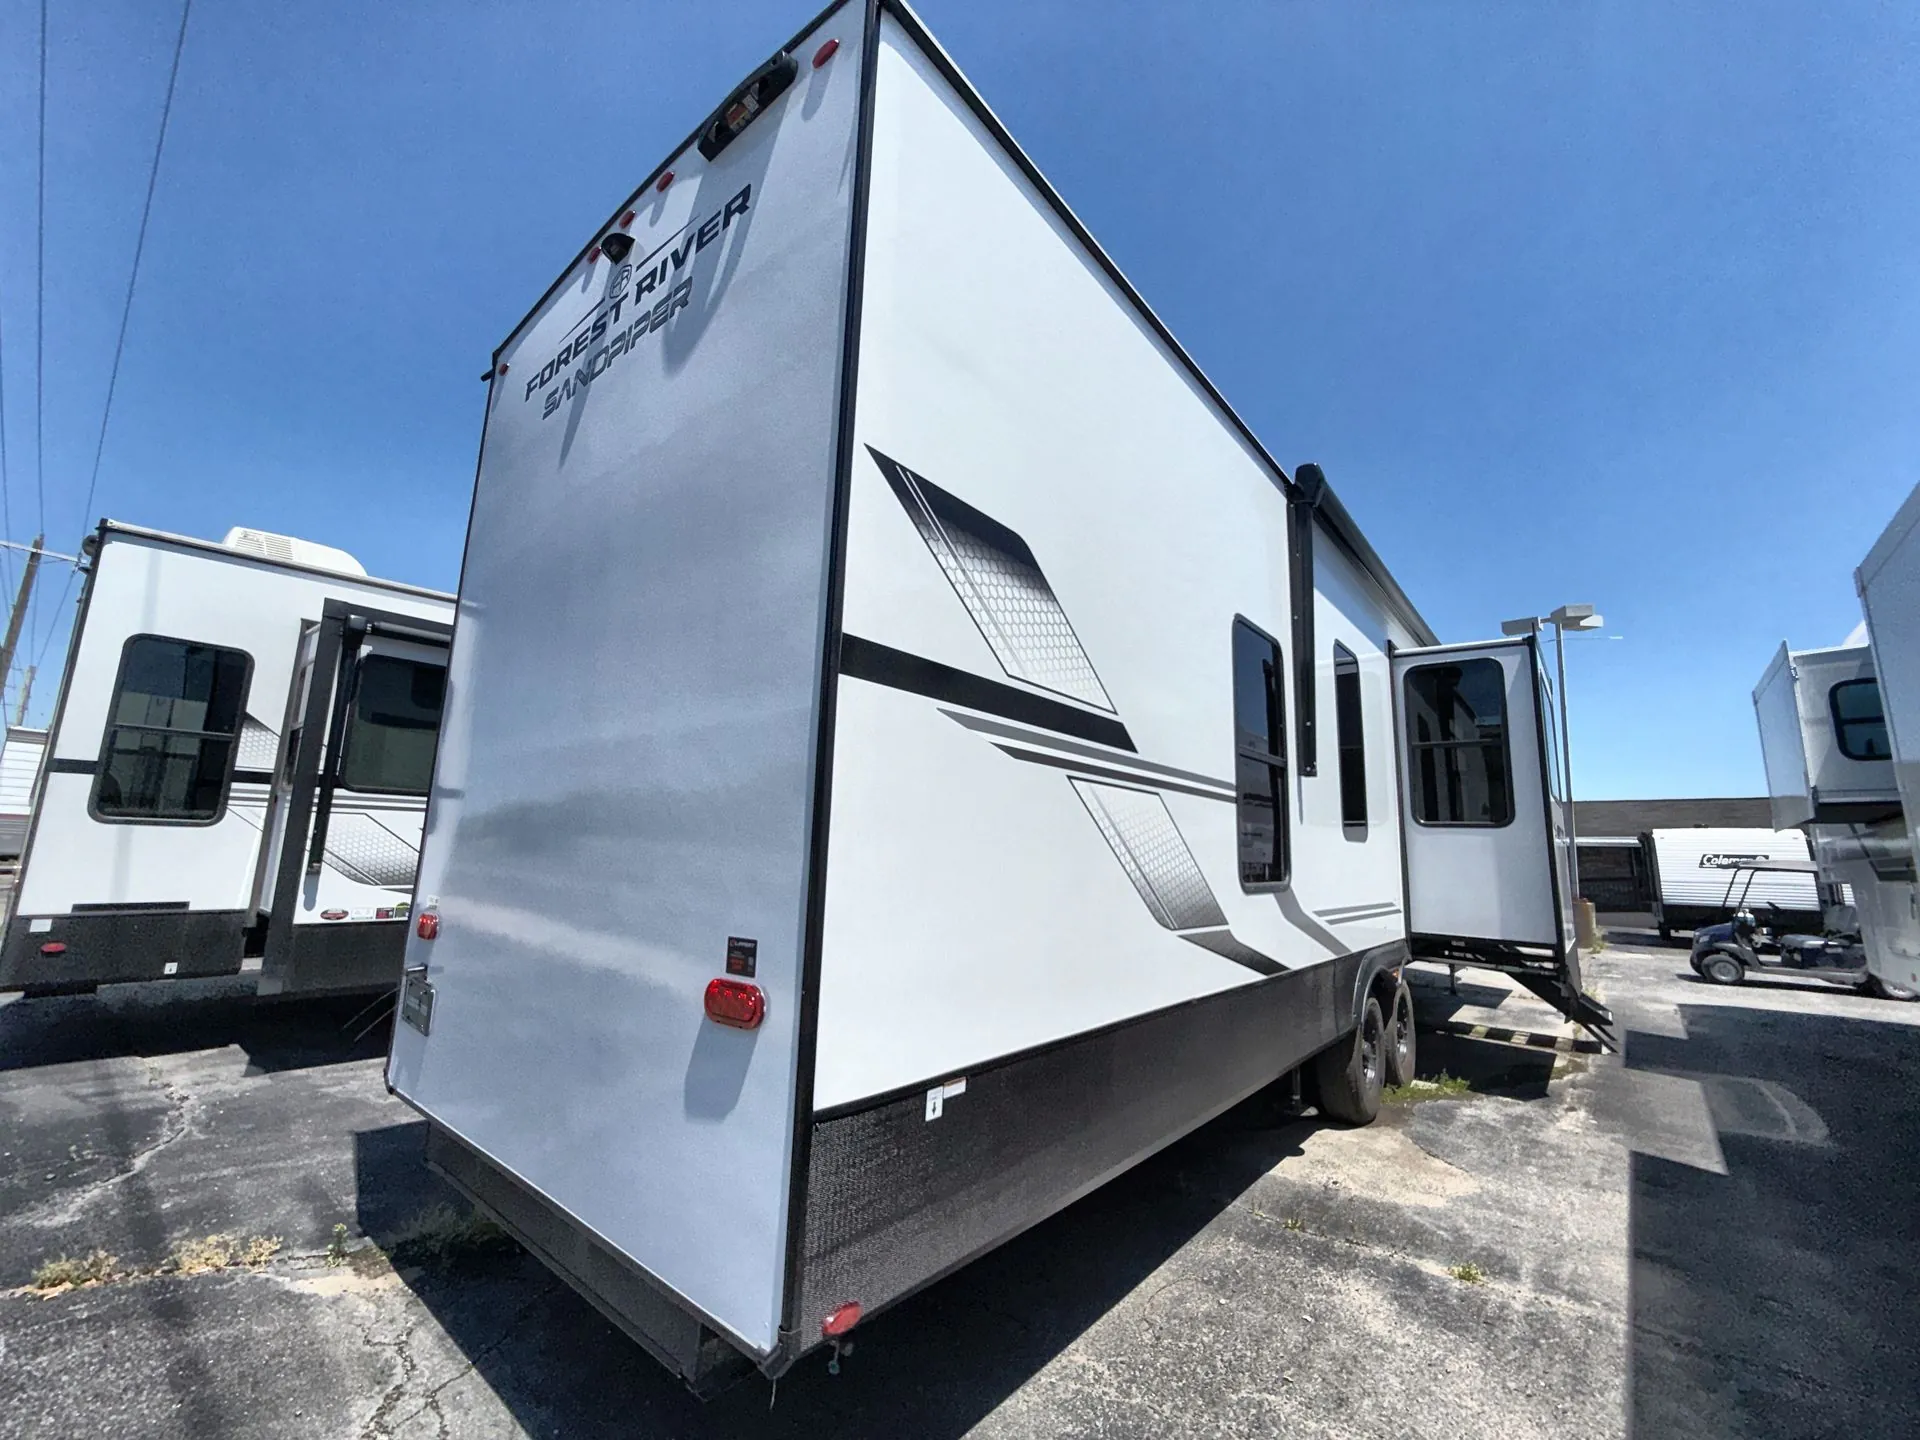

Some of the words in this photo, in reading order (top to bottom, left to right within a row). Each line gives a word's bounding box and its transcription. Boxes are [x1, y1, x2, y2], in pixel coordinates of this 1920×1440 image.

[524, 293, 629, 402] FOREST
[634, 183, 752, 306] RIVER
[541, 275, 693, 420] SANDPIPER
[1702, 854, 1754, 865] Colem
